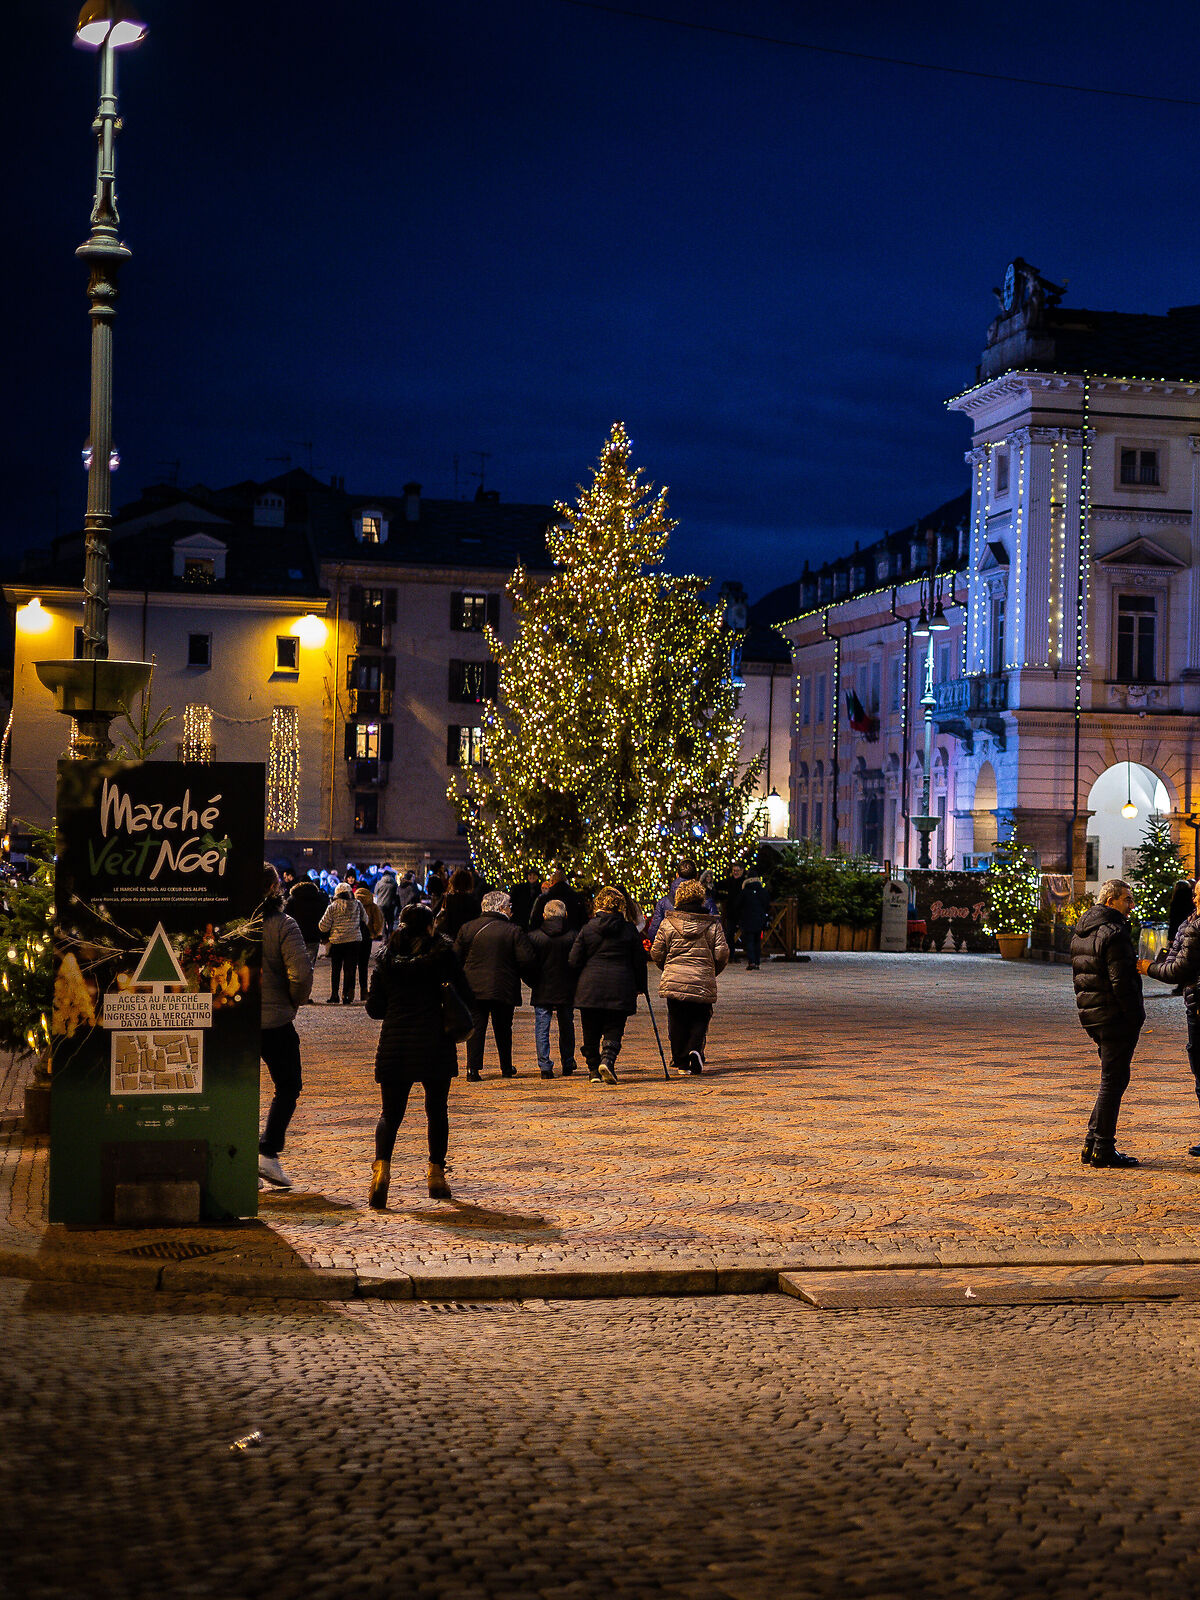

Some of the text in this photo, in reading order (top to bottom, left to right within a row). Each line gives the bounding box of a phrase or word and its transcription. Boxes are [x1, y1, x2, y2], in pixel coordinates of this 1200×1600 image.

[100, 777, 222, 838] Marché
[88, 833, 161, 877] Vert
[118, 994, 199, 1004] ACCÈS AU MARCHÉ
[106, 1004, 136, 1012] DEPUIS
[150, 1003, 166, 1011] RUE
[168, 1003, 180, 1011] DE
[180, 1003, 210, 1011] TILLIER
[104, 1011, 211, 1021] INGRESSO AL MERCATINO
[163, 1019, 194, 1027] TILLIER
